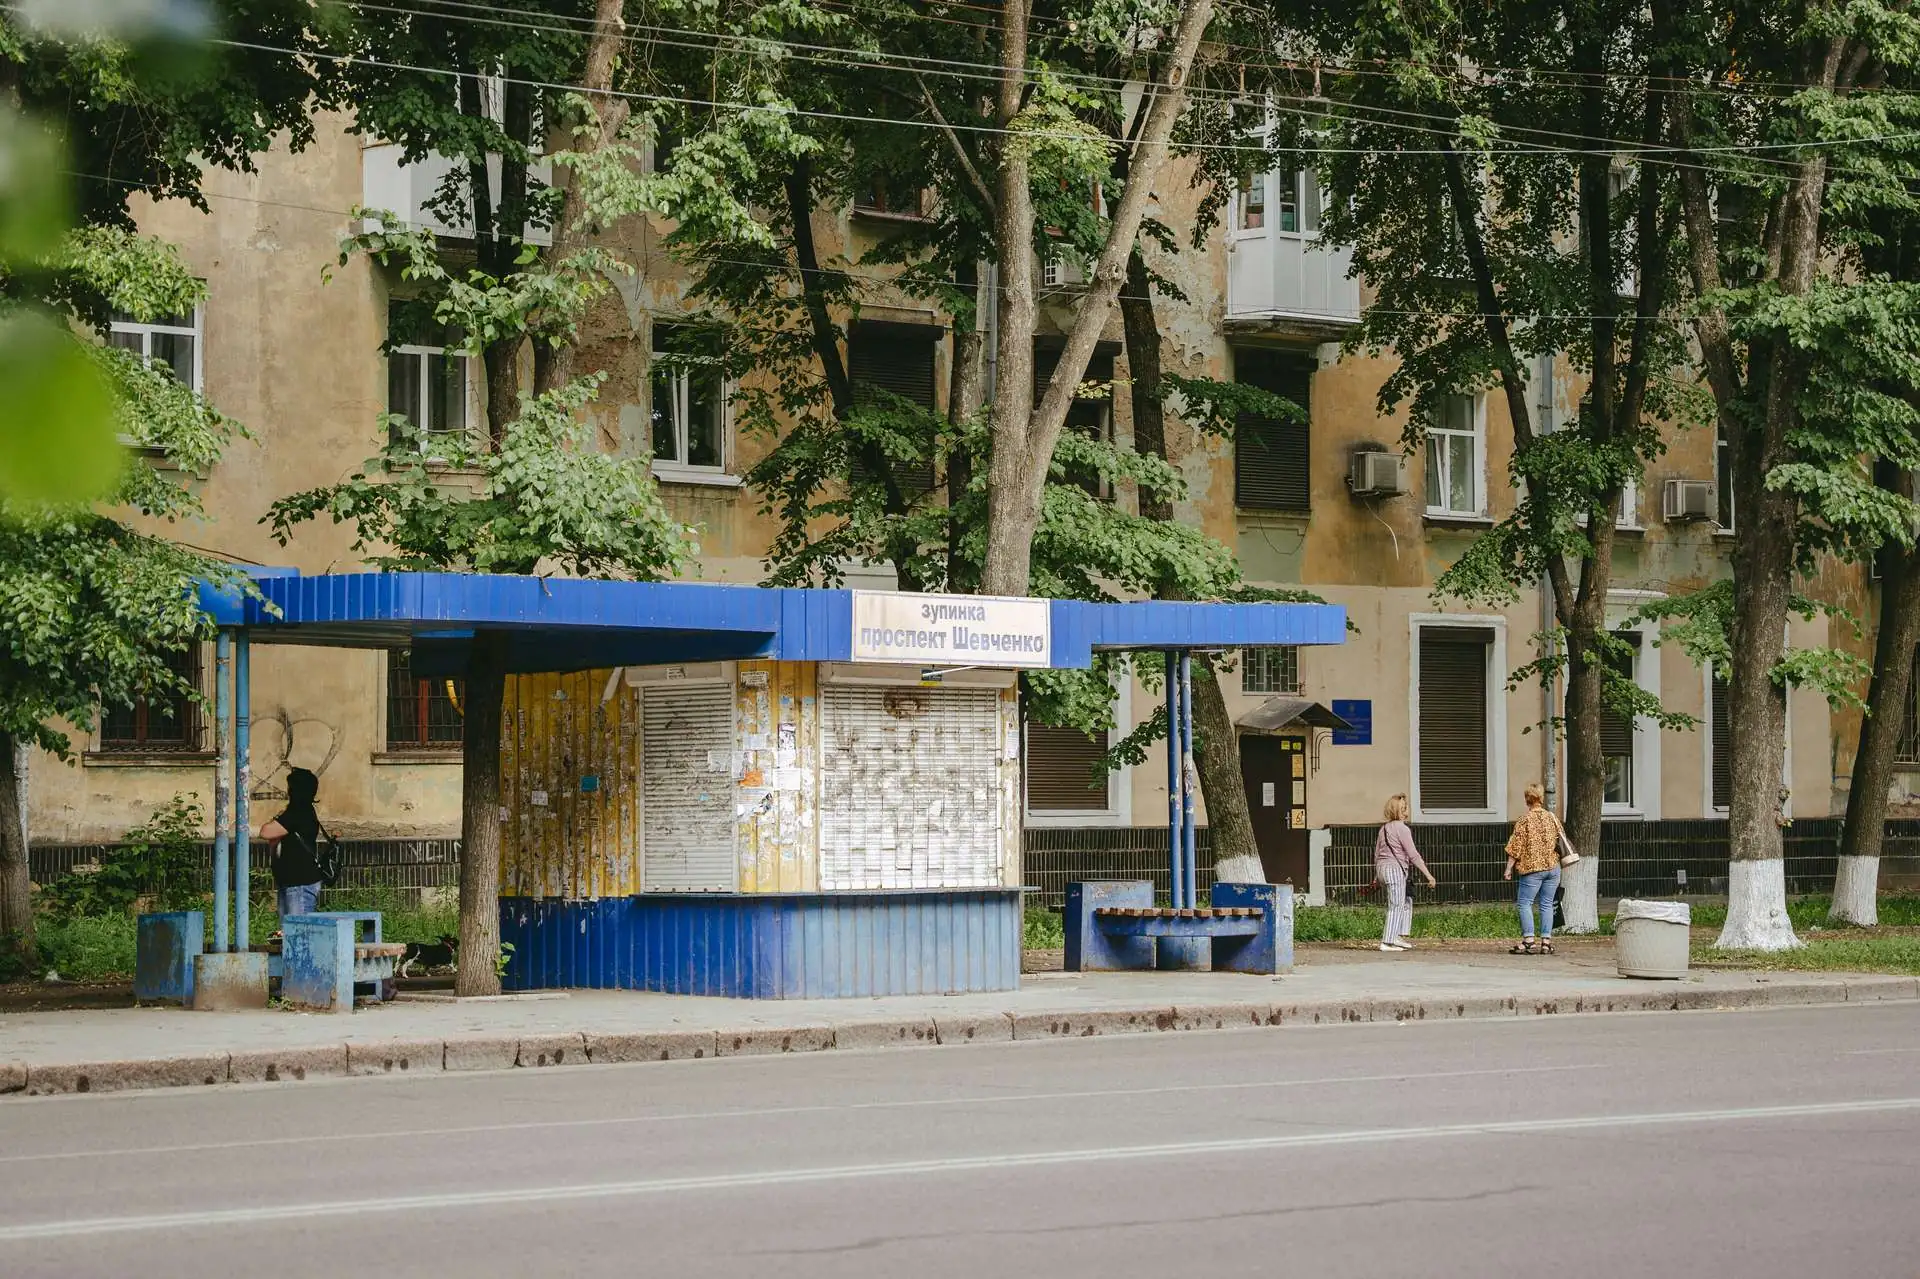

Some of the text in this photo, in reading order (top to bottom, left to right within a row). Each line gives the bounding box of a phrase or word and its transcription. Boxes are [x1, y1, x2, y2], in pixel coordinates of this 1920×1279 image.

[921, 603, 985, 624] зупинка
[861, 626, 1044, 653] проспект Шевченко
